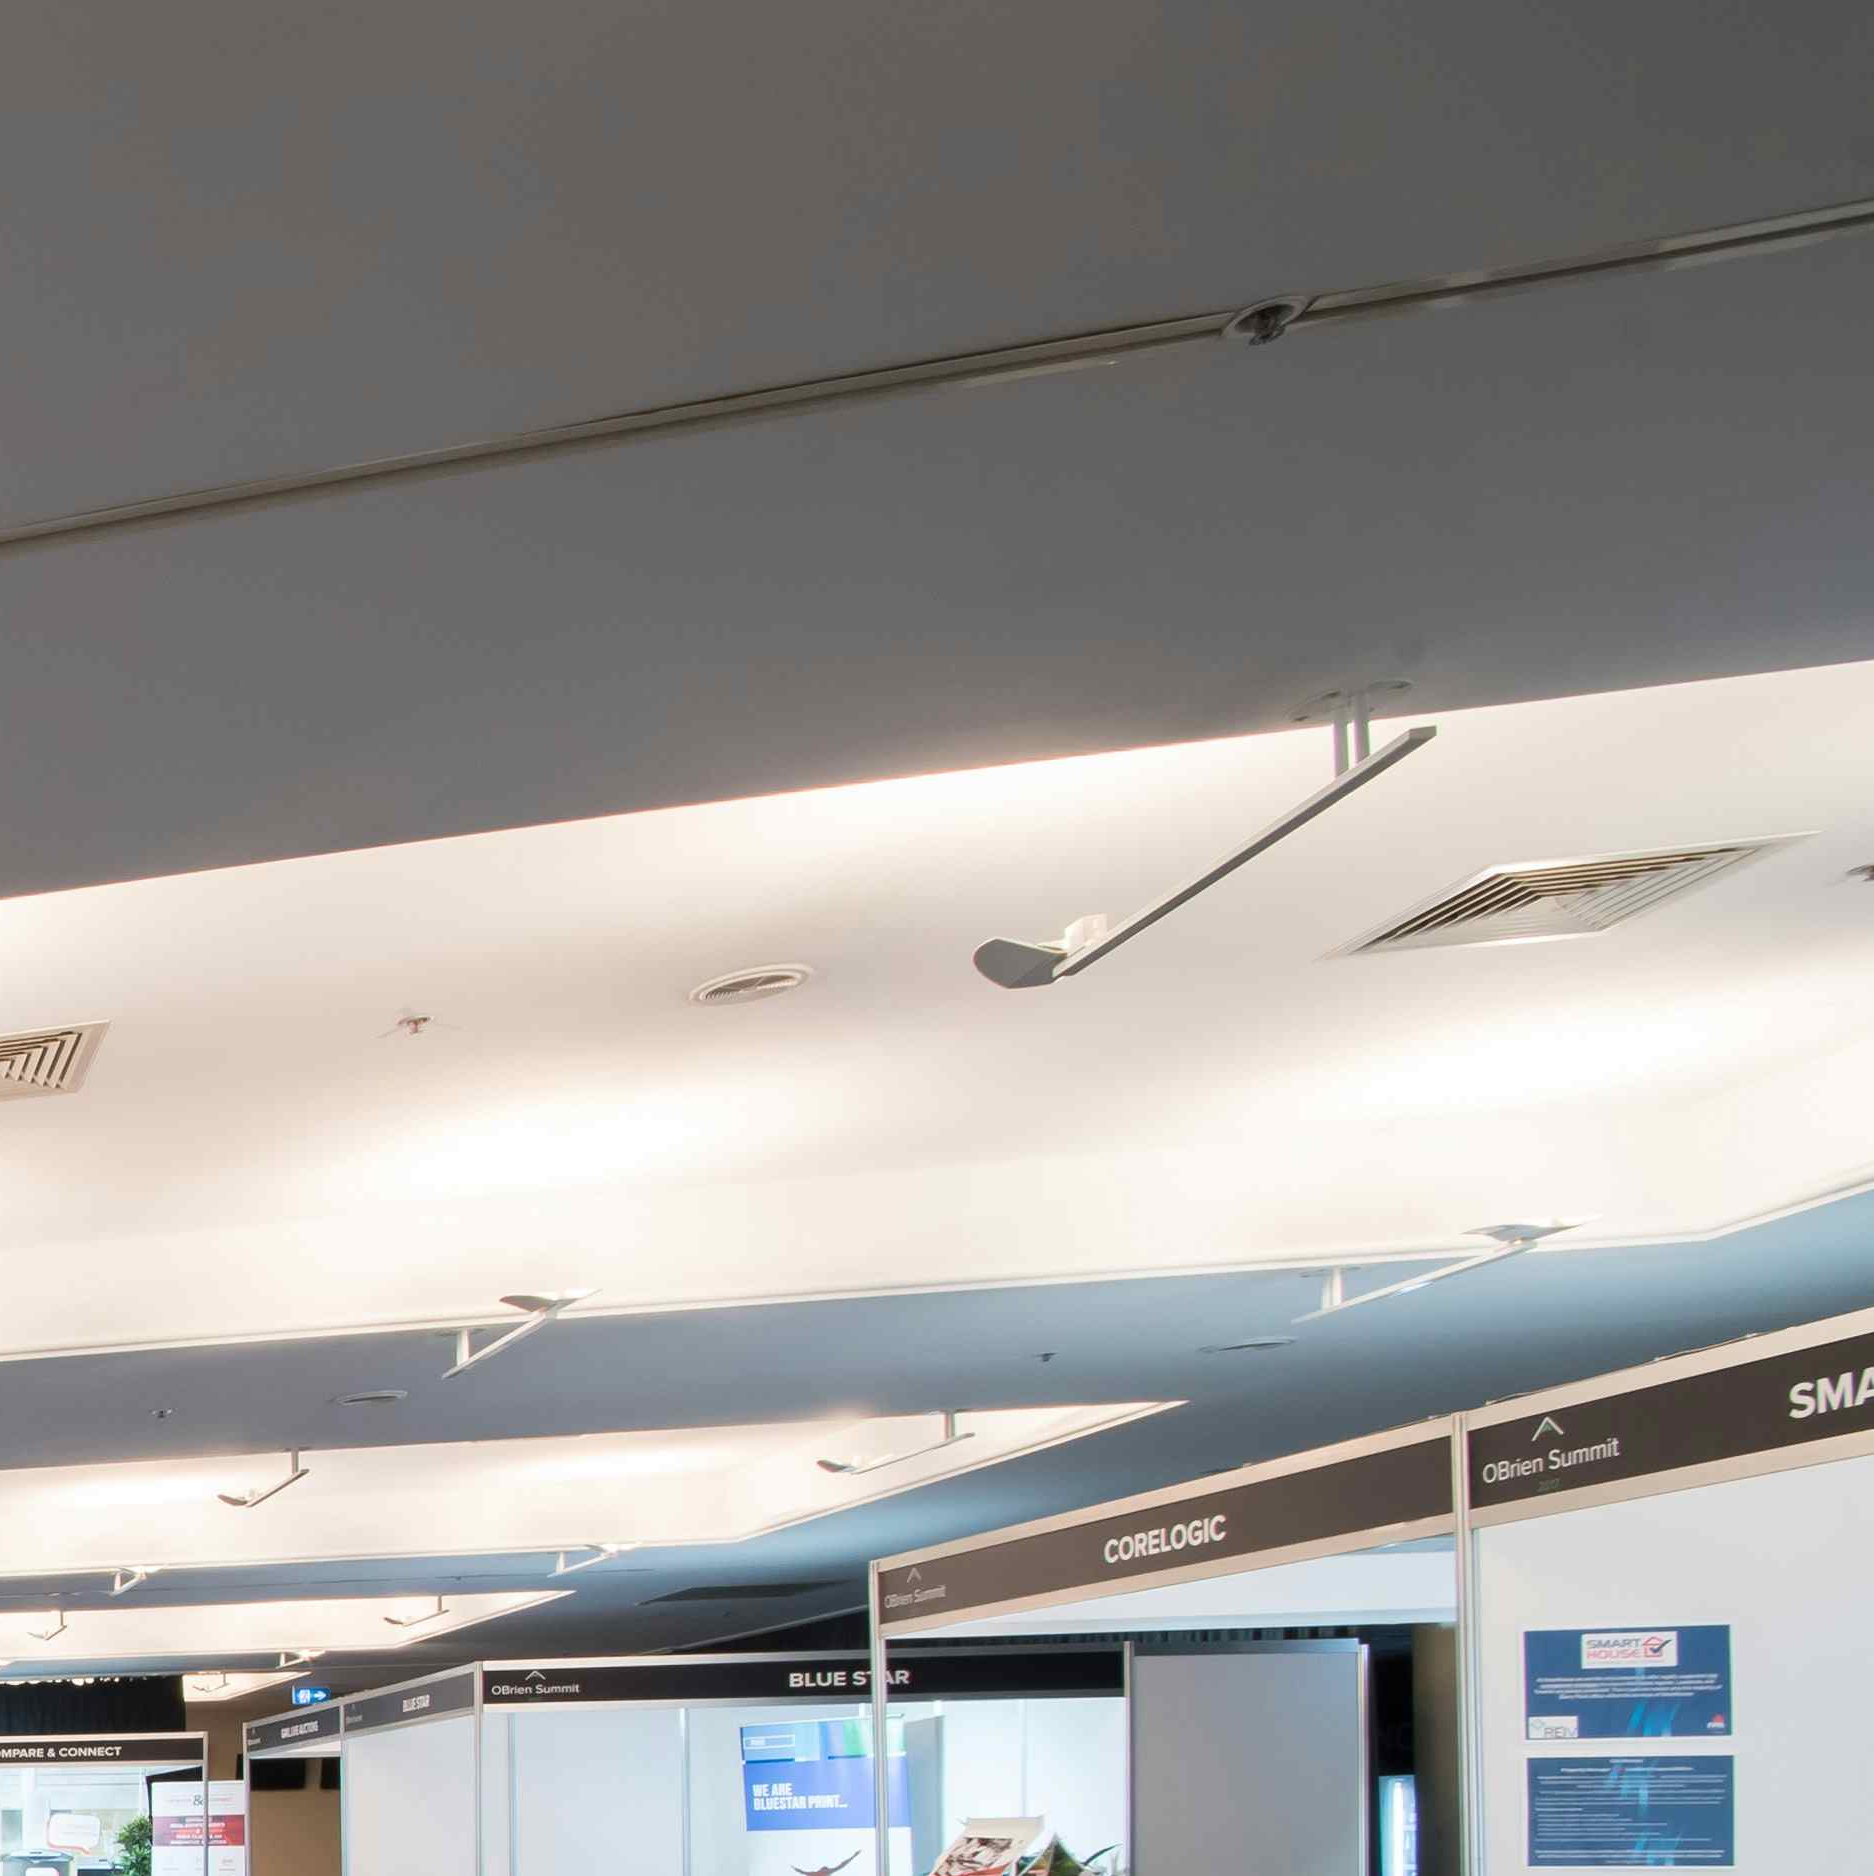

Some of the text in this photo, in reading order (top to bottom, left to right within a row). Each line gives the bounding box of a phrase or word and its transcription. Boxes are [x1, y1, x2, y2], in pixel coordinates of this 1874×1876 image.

[1482, 1438, 1620, 1484] OBrien Summit
[1103, 1514, 1227, 1564] CORELOGIC
[1586, 1638, 1642, 1649] SMART
[1586, 1650, 1641, 1660] HOUSE
[789, 1672, 847, 1688] BLUE
[491, 1683, 580, 1696] OBrien Summit
[47, 1749, 56, 1758] &
[59, 1746, 122, 1757] CONNECT
[752, 1783, 792, 1797] WE ARE
[753, 1796, 807, 1811] BLUESTAR
